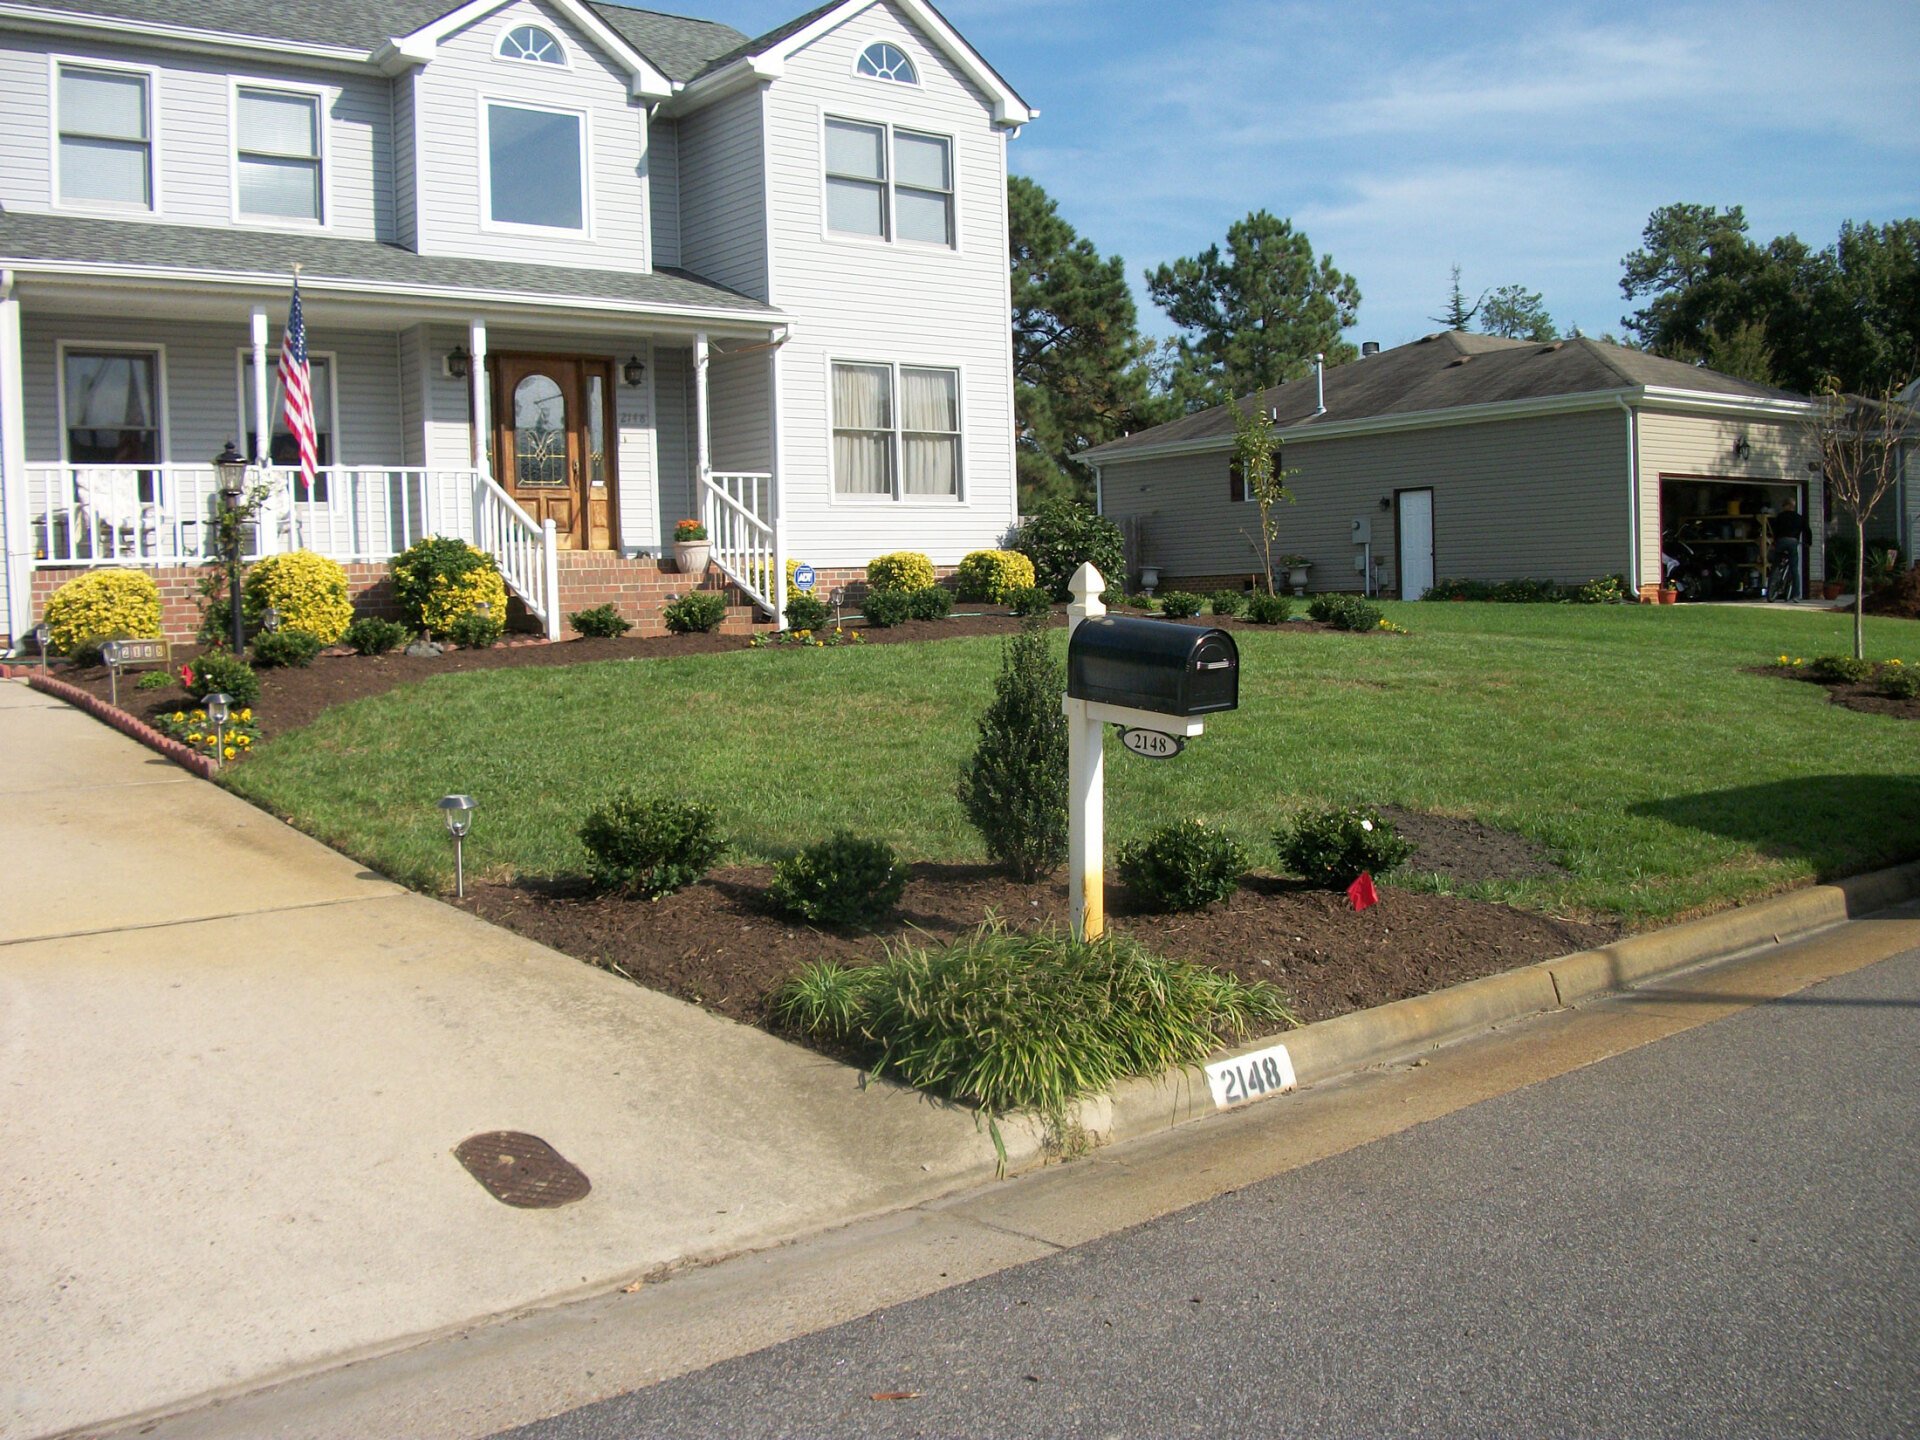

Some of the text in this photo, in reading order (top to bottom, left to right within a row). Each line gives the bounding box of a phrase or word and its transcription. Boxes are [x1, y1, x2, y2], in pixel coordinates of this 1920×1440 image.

[620, 413, 646, 424] 2148
[122, 646, 163, 658] 2148
[1134, 734, 1167, 753] 2148
[1221, 1057, 1281, 1104] 2148
